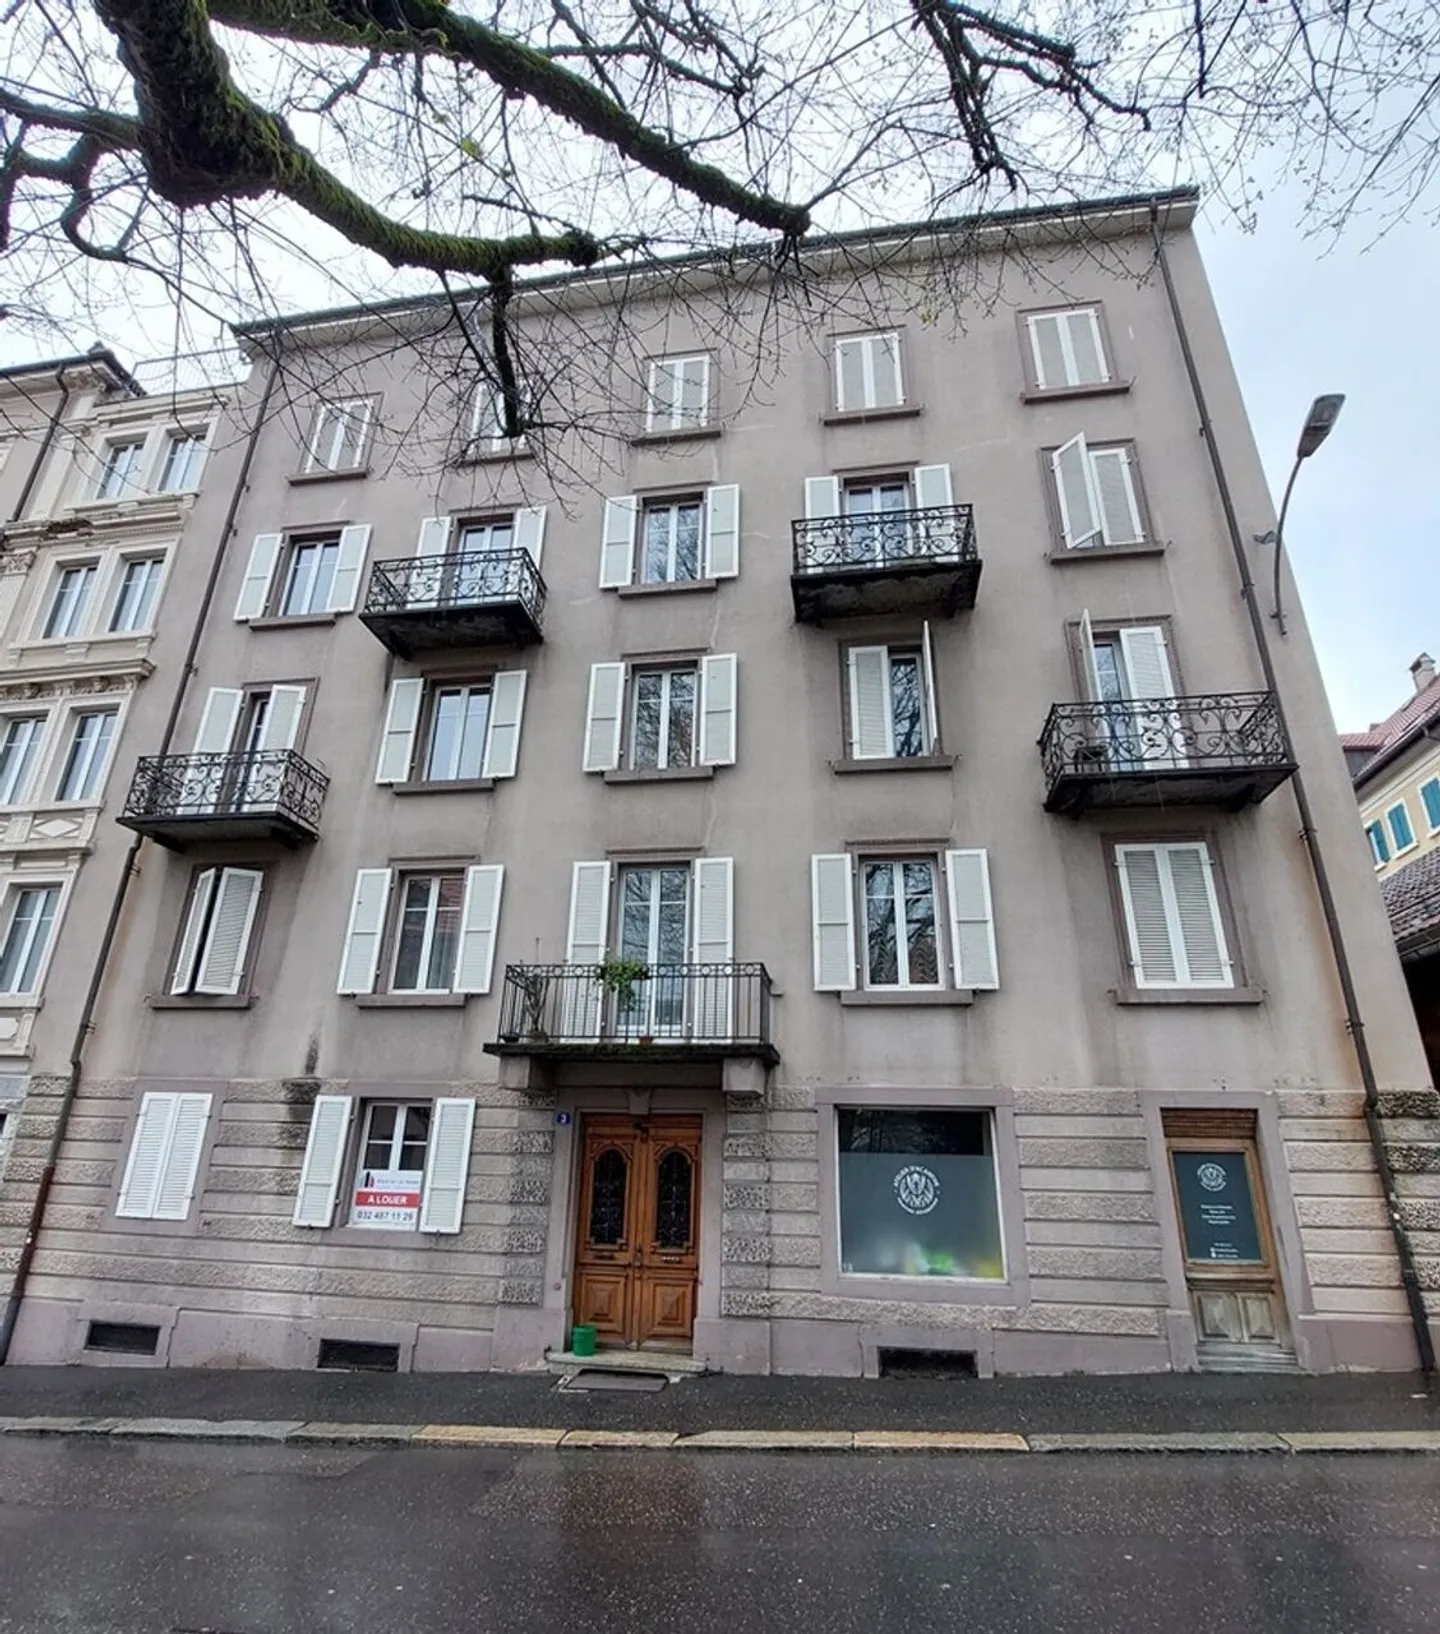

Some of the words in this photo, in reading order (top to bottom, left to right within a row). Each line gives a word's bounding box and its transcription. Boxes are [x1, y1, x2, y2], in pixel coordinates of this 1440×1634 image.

[560, 1113, 567, 1124] 3
[367, 1194, 375, 1204] A
[376, 1194, 408, 1205] LOUER
[357, 1210, 373, 1220] 032
